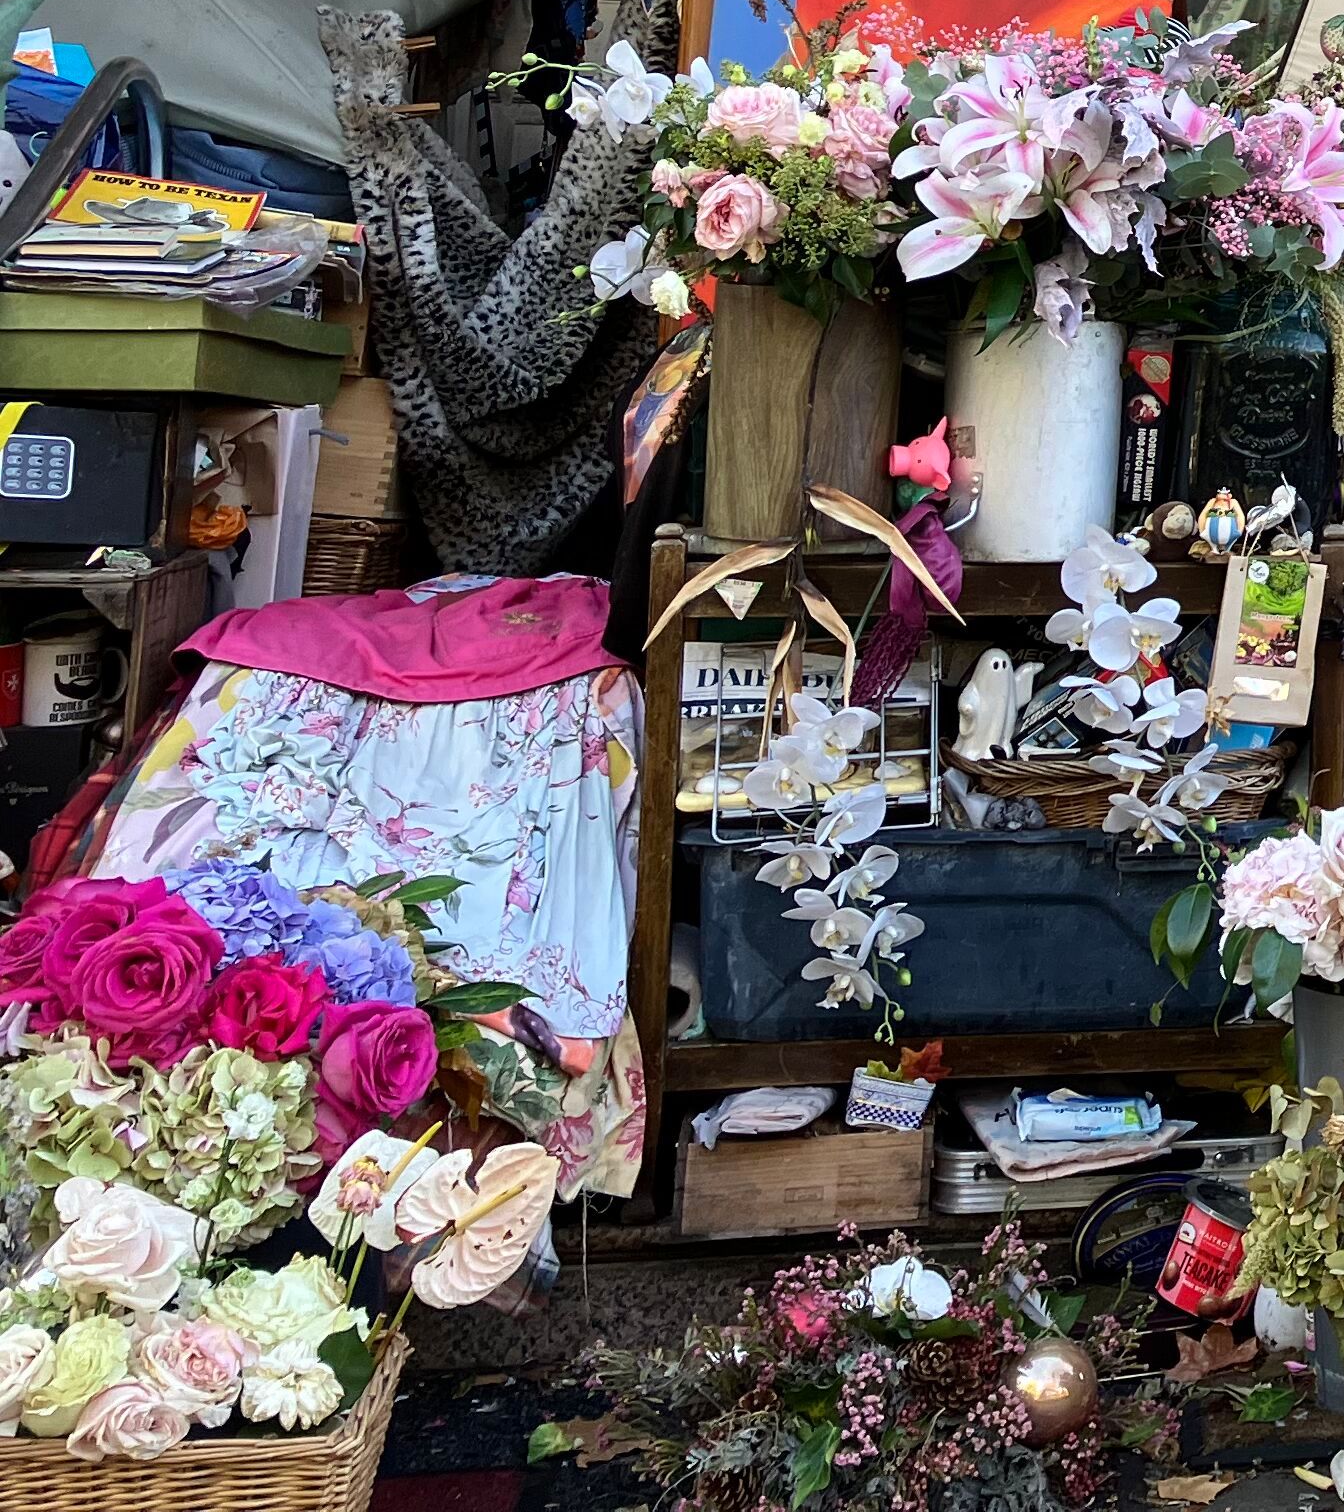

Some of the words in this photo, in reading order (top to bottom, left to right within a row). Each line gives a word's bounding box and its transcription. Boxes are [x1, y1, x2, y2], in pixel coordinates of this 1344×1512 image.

[93, 174, 136, 190] HOW
[138, 180, 161, 192] TO
[164, 184, 191, 197] BE
[193, 188, 254, 205] TEXAN
[1147, 428, 1158, 465] WORLD'S
[1182, 1251, 1232, 1290] TEACAKE
